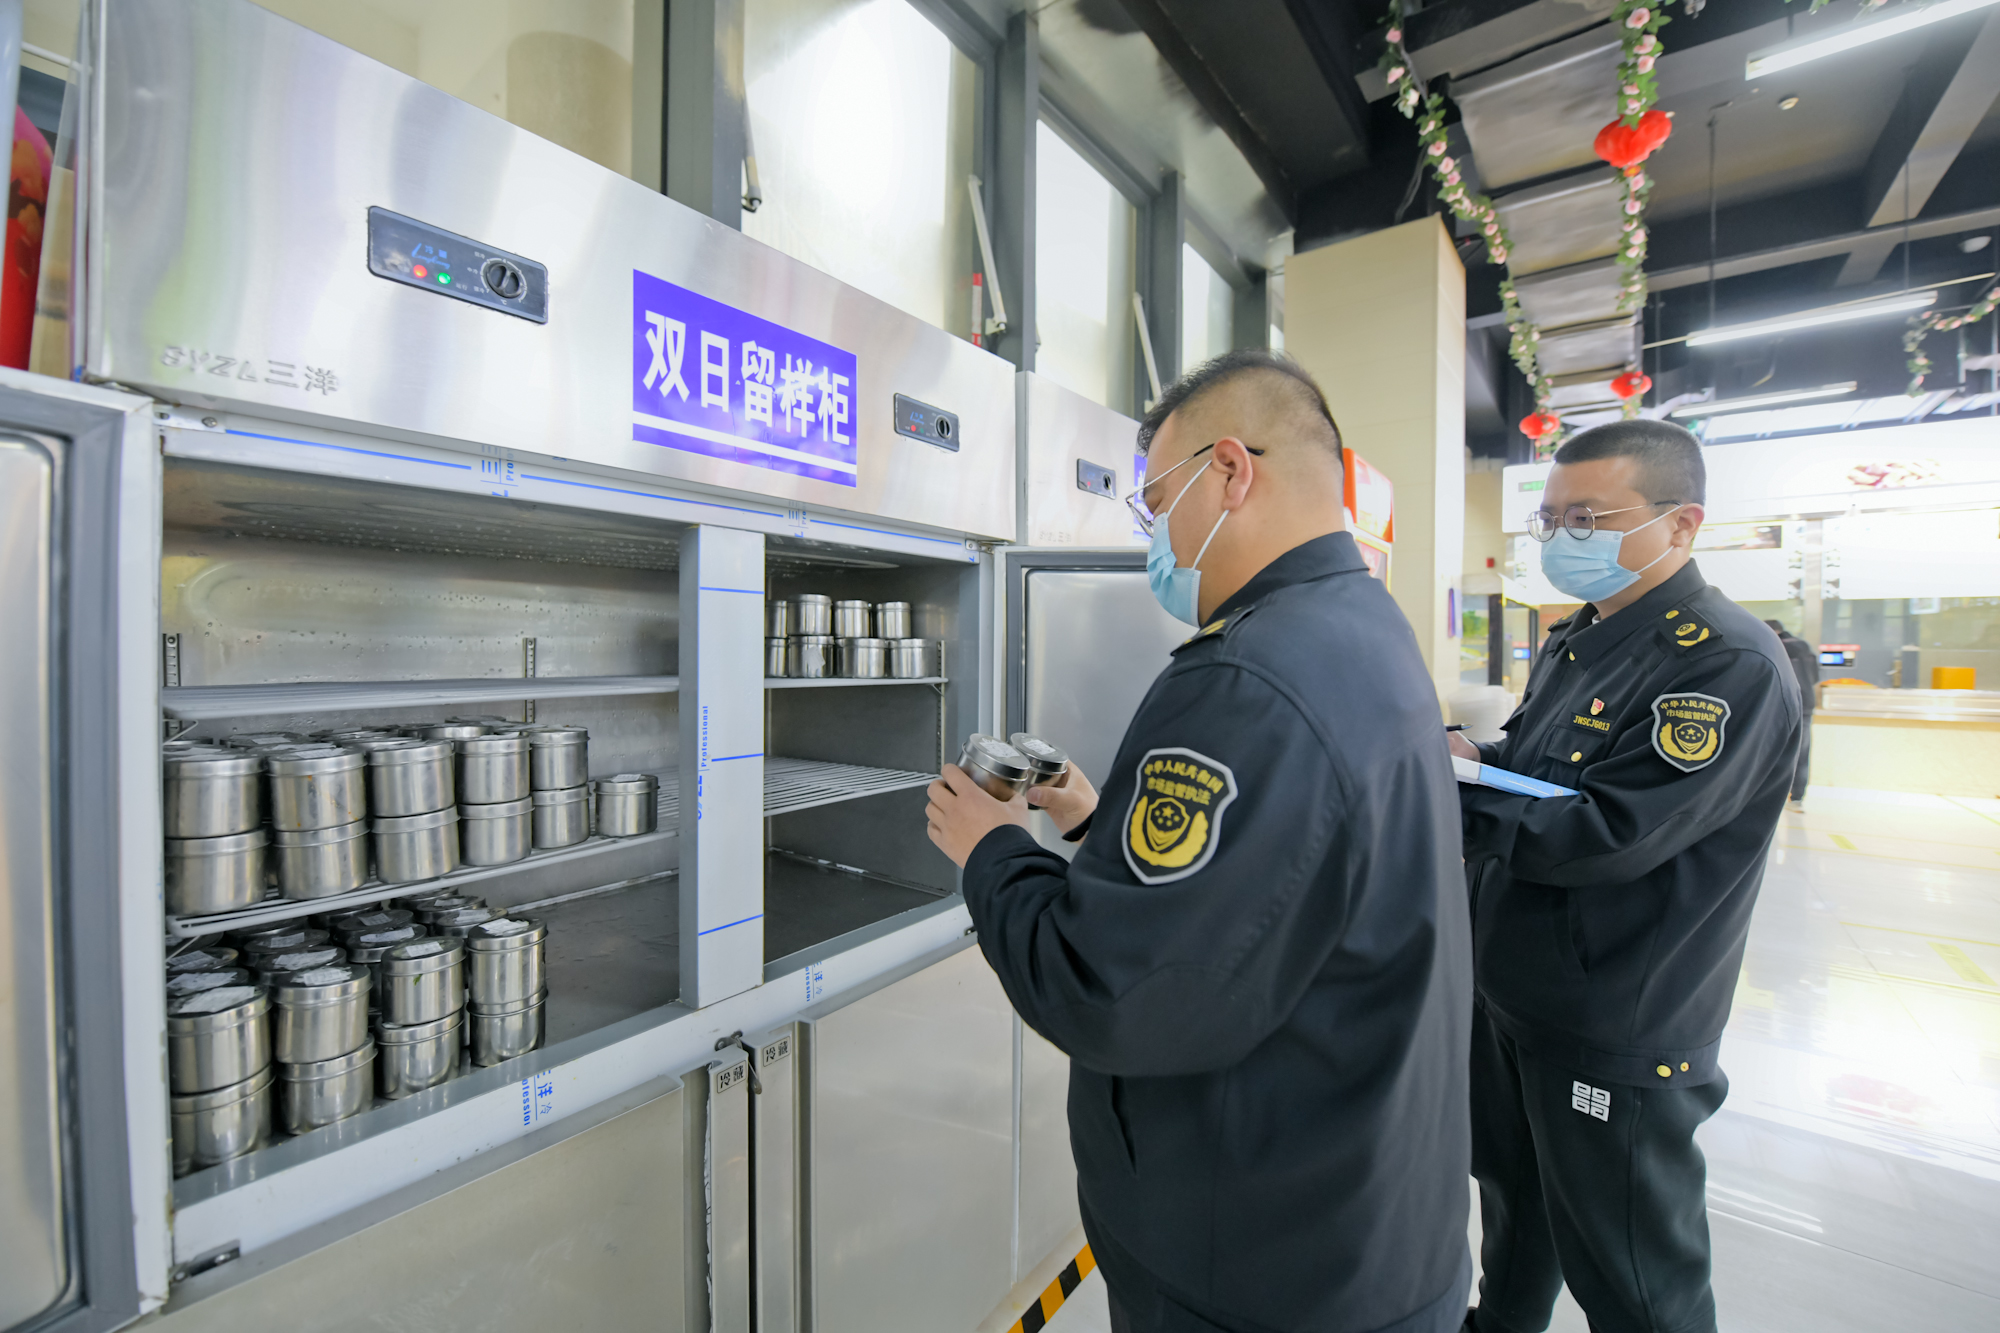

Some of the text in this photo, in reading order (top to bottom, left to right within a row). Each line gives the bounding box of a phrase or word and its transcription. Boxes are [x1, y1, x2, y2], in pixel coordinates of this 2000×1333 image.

[642, 309, 850, 446] 双日留样柜
[1660, 699, 1724, 716] 中华人民共和国
[1666, 709, 1717, 722] 市场监管执法
[701, 705, 709, 767] Professional
[1144, 760, 1225, 794] 中华人民共和国
[766, 1040, 790, 1063] 冷藏
[720, 1065, 744, 1089] 冷藏
